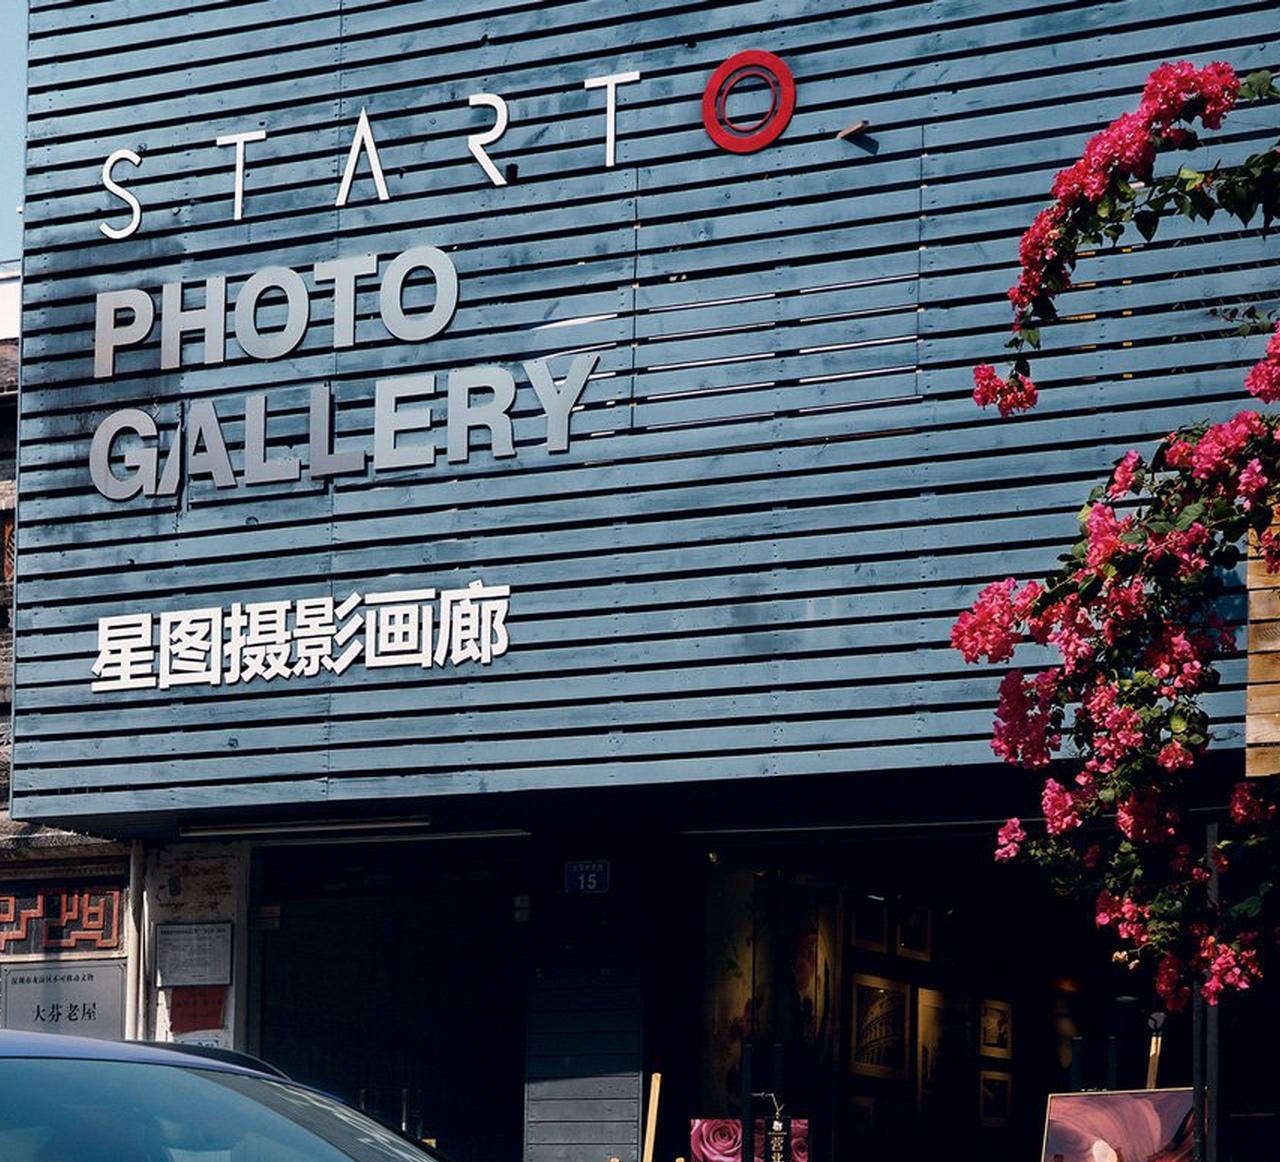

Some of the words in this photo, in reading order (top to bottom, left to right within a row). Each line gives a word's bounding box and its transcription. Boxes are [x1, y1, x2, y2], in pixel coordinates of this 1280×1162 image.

[94, 246, 460, 380] PHOTO
[88, 354, 601, 501] GALLERY
[90, 580, 511, 692] 星图摄影画廊
[578, 873, 597, 890] 15
[33, 1001, 97, 1023] 大芬老屋
